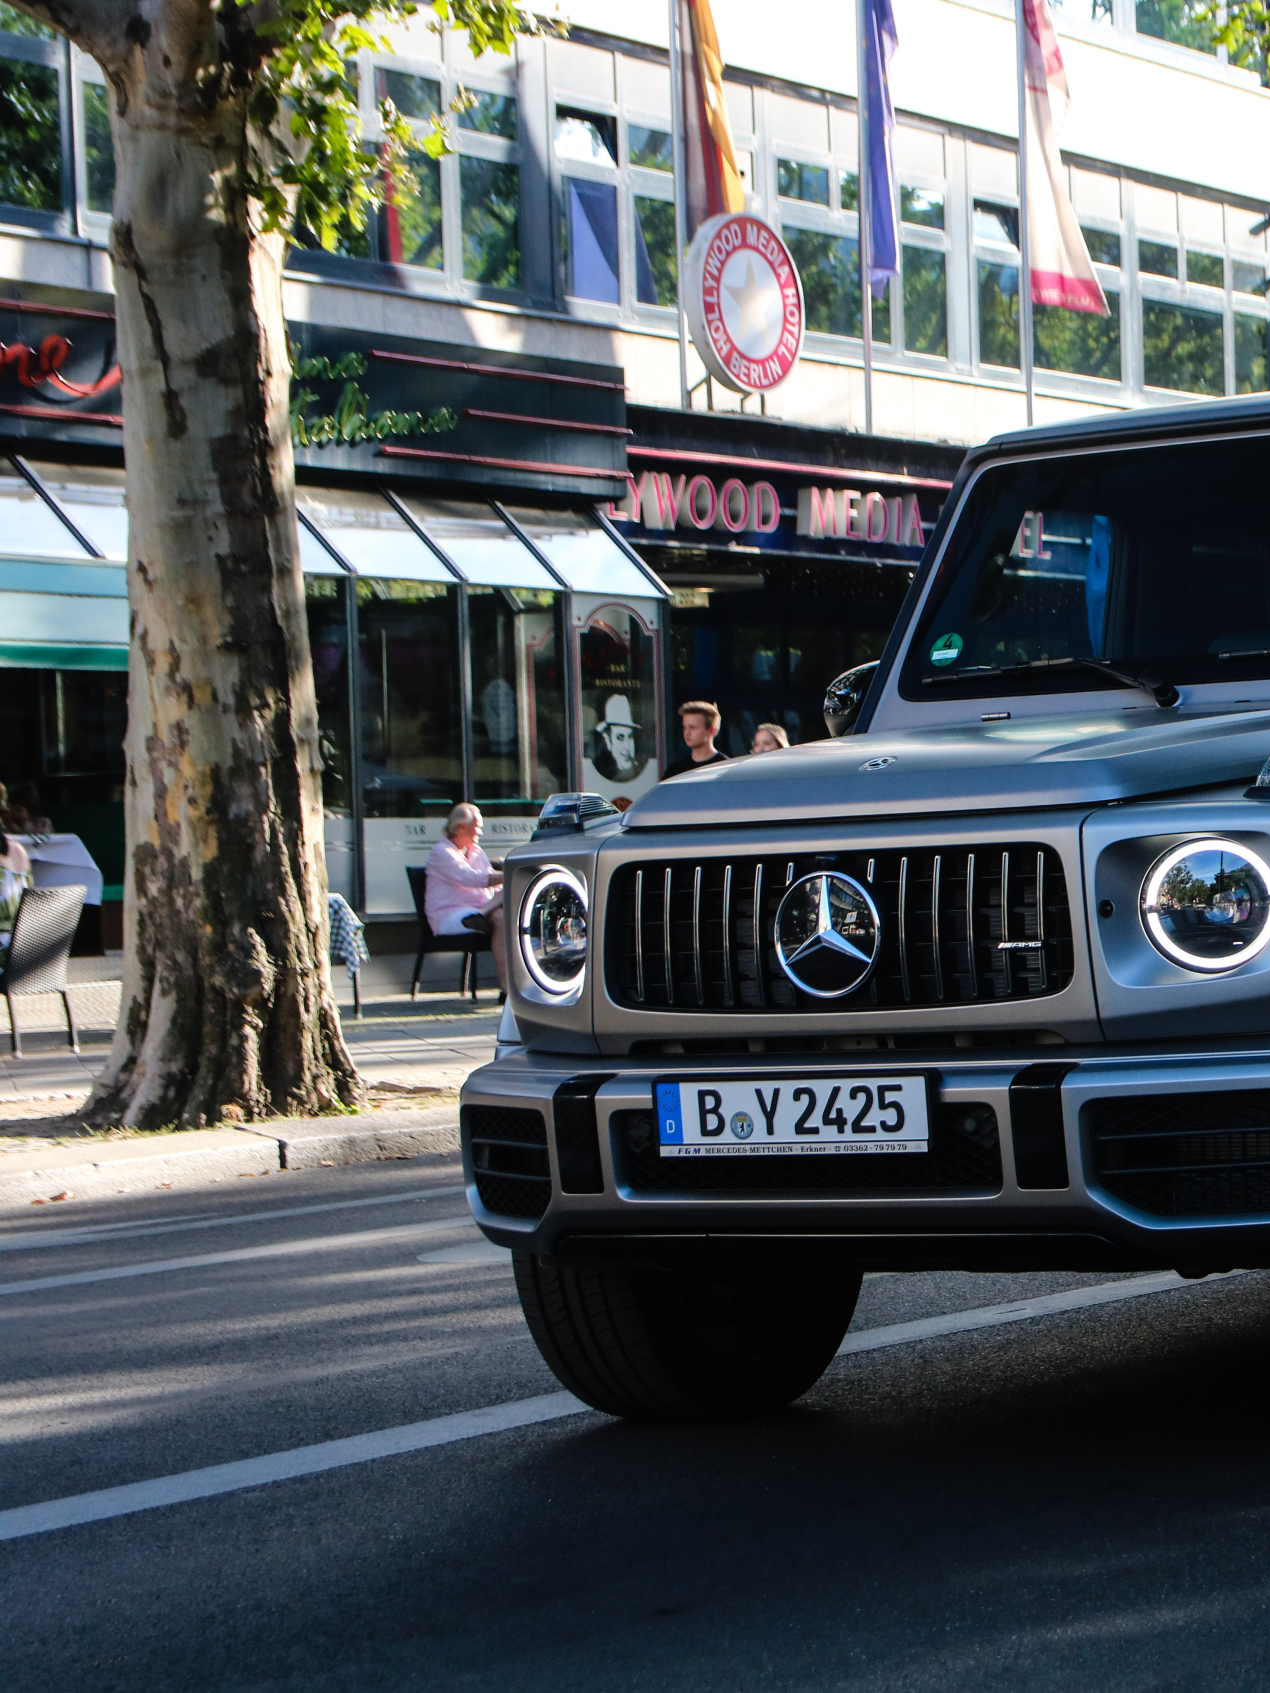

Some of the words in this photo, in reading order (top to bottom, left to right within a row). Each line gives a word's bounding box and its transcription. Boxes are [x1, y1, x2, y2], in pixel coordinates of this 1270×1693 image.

[745, 222, 791, 285] MEDIA
[704, 222, 742, 358] HOLLYWOOD
[778, 286, 799, 362] HOTEL
[729, 350, 784, 388] BERLIN
[606, 470, 780, 534] LYWOOD
[797, 485, 926, 548] MEDIA
[943, 634, 953, 649] 4
[491, 822, 538, 834] RISTORA
[666, 1119, 676, 1134] D
[697, 1089, 726, 1137] B
[754, 1087, 781, 1135] Y
[792, 1083, 905, 1135] 2425
[800, 1145, 827, 1153] Erkner
[843, 1143, 869, 1152] 03362
